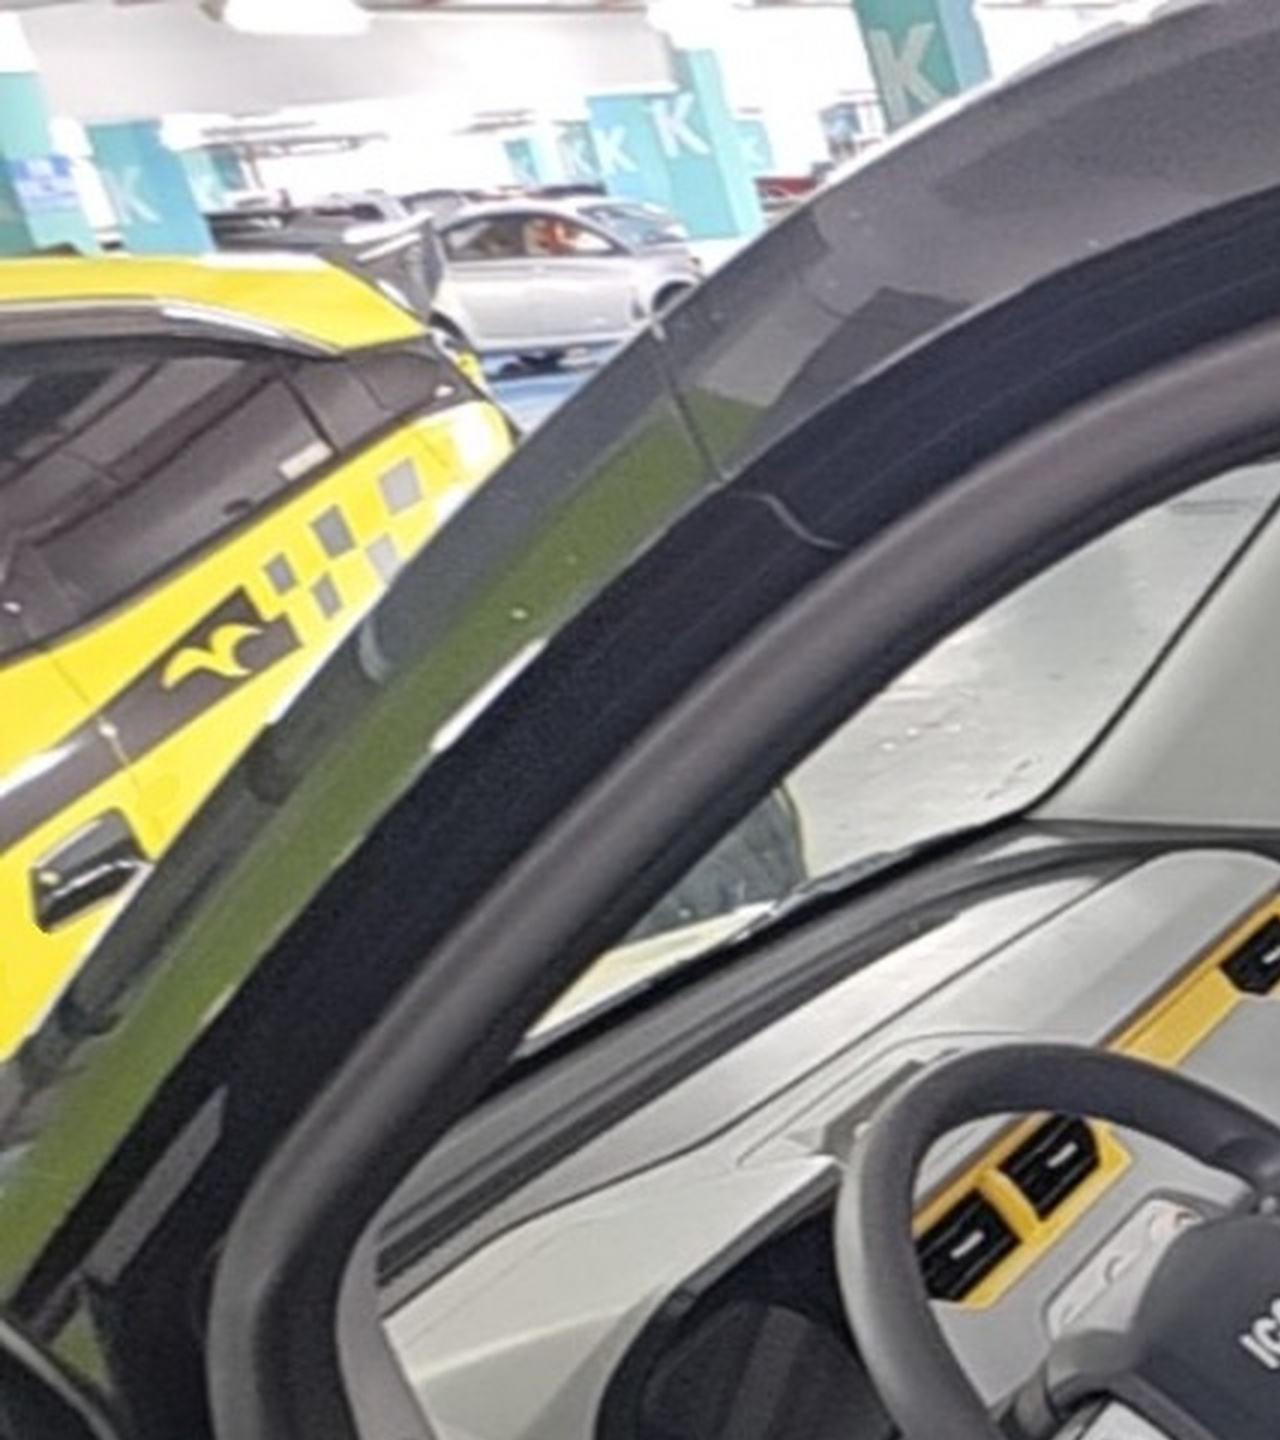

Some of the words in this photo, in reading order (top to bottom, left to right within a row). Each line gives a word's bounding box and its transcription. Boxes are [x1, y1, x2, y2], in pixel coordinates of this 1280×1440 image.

[868, 23, 943, 123] K
[593, 126, 639, 177] K
[652, 92, 712, 159] K
[103, 164, 163, 225] K
